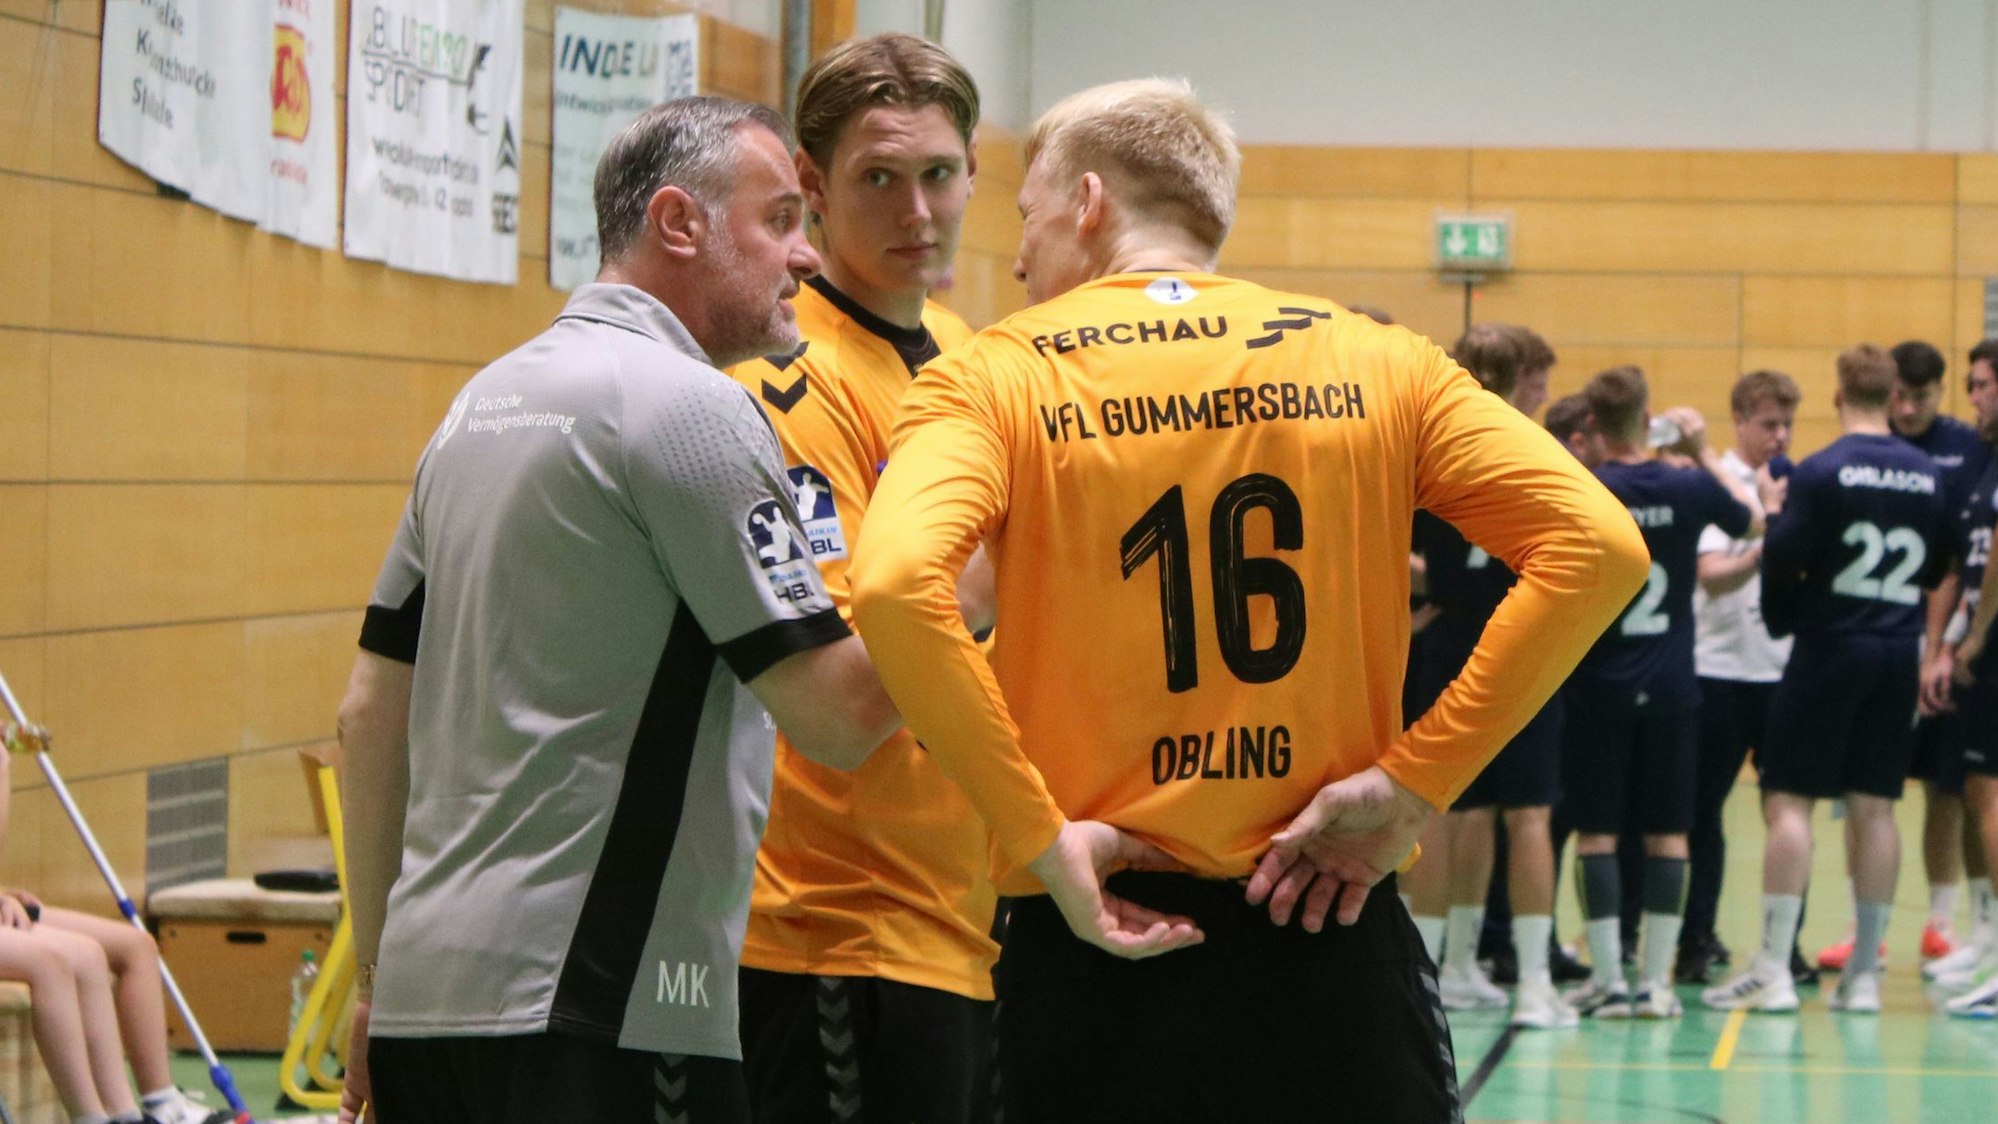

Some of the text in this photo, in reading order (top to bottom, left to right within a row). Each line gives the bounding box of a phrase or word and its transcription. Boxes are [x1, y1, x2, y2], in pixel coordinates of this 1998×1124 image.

[1032, 315, 1228, 357] FERCHAU
[468, 411, 576, 434] Vermögensberatung
[475, 394, 523, 412] Deutsche
[1040, 382, 1365, 443] VFL GUMMERSBACH
[810, 538, 842, 554] BL
[1831, 521, 1926, 606] 22
[1120, 473, 1306, 693] 16
[1151, 725, 1291, 785] OBLING
[656, 960, 710, 1008] MK
